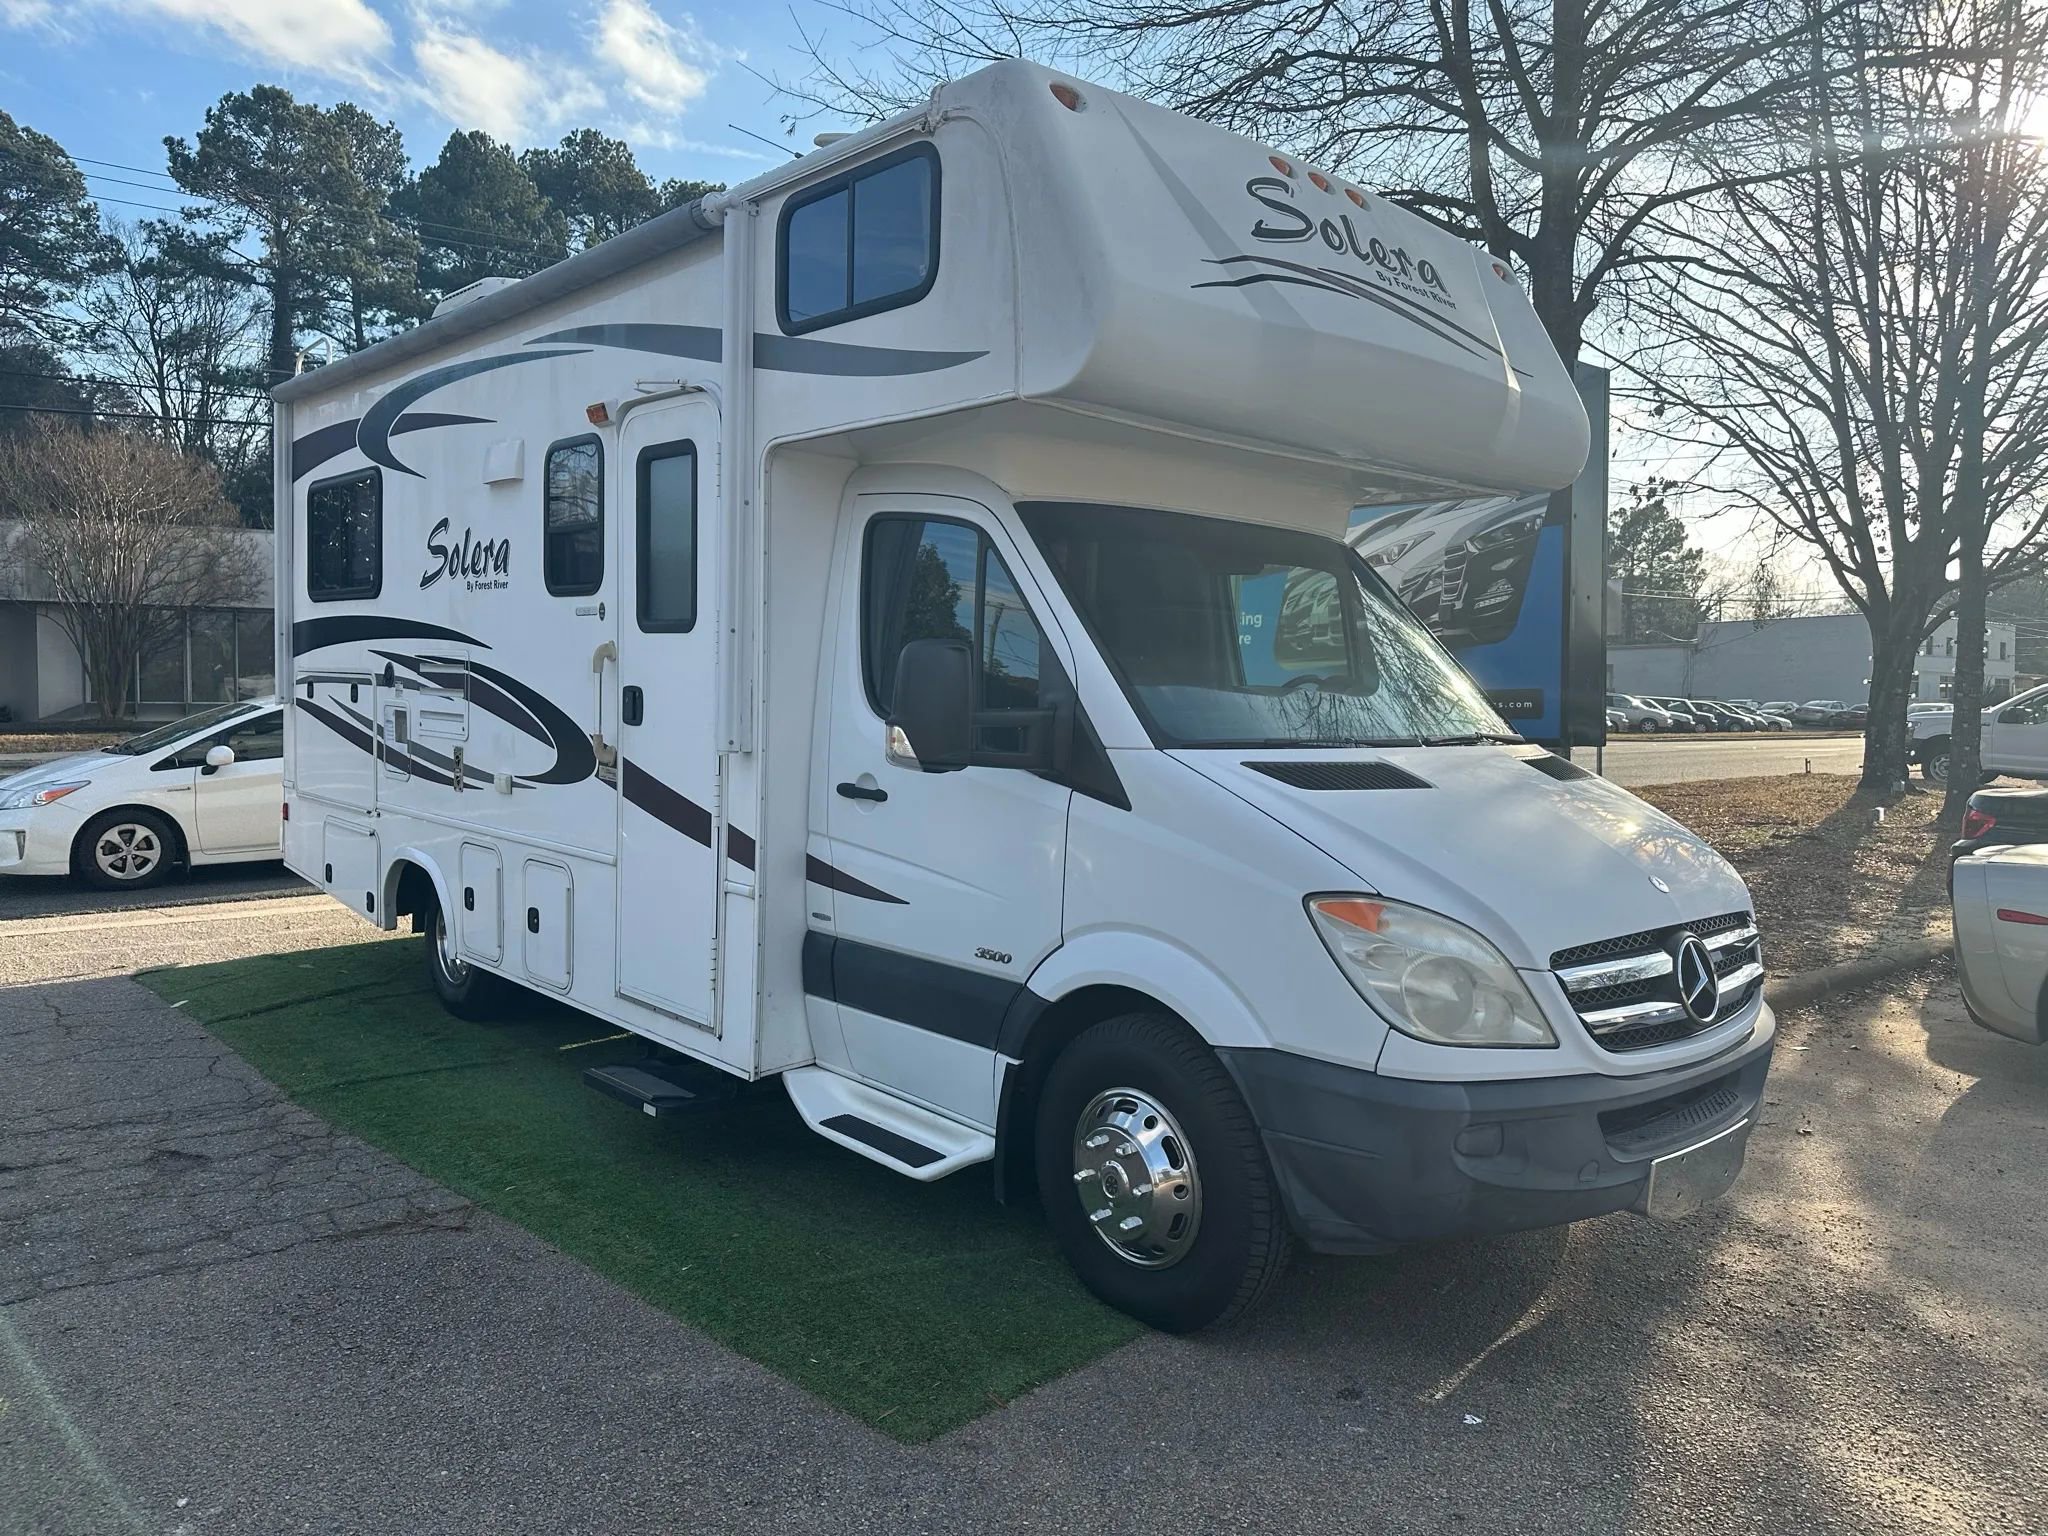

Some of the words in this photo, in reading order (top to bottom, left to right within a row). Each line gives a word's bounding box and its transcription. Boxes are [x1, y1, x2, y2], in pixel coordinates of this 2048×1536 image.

[1246, 176, 1451, 298] Solera
[1375, 270, 1393, 287] By
[1392, 276, 1431, 299] Forest
[1428, 290, 1457, 310] River
[420, 517, 511, 591] Solera
[466, 580, 474, 593] By
[475, 580, 492, 590] Forest
[493, 579, 509, 590] River
[1238, 634, 1252, 645] re
[974, 947, 1013, 965] 3500
